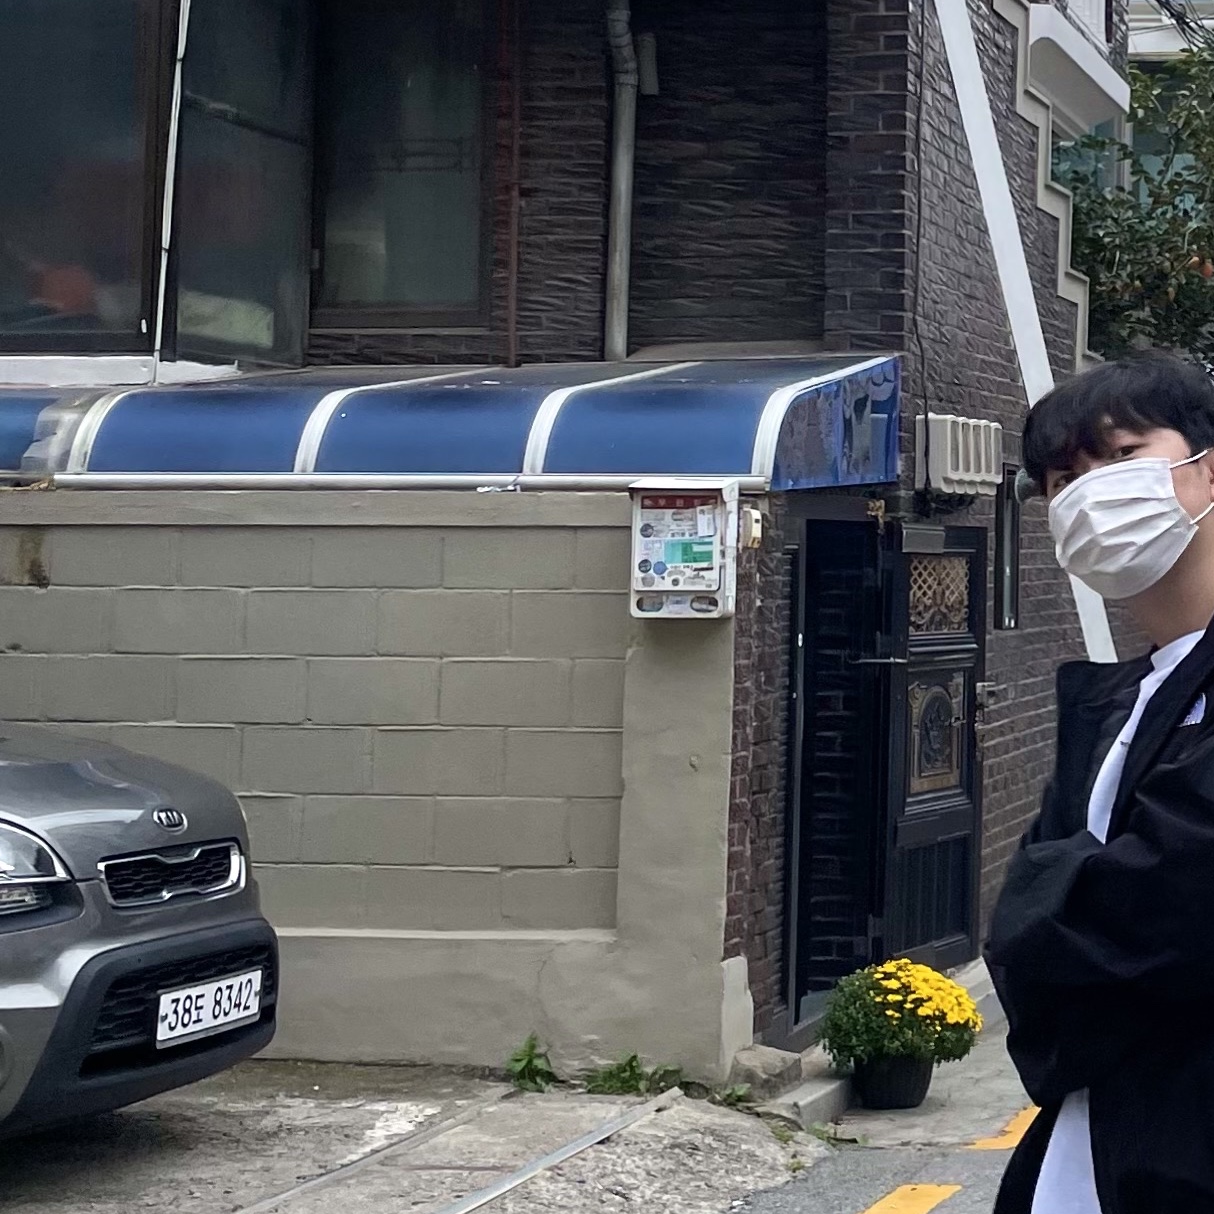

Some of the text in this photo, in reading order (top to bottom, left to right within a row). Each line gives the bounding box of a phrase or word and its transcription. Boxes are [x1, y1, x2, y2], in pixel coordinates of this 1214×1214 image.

[158, 810, 182, 826] KIA
[168, 977, 253, 1032] 38도 8342
